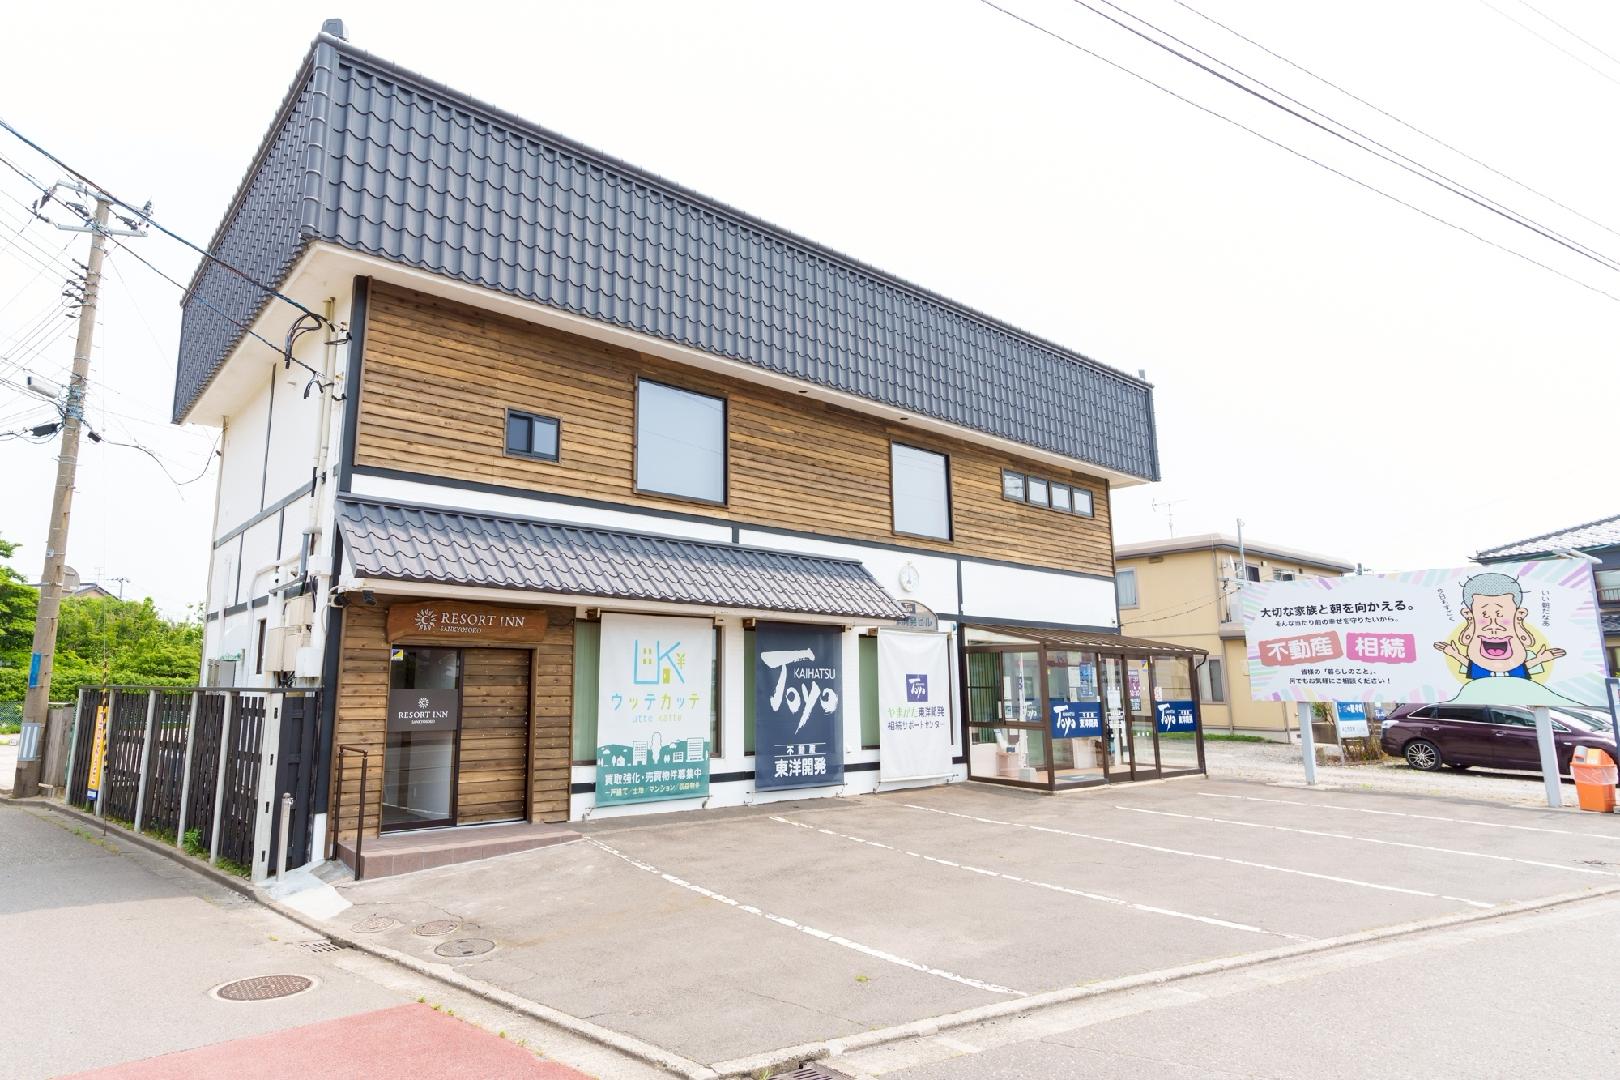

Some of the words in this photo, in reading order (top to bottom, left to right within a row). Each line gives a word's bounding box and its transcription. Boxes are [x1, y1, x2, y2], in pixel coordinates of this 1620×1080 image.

[1260, 600, 1415, 618] 大切な家族と朝を向かえる。
[440, 612, 497, 626] RESORT
[500, 616, 526, 627] INN
[1267, 636, 1334, 661] 不動産
[1355, 637, 1406, 659] 相続
[794, 667, 836, 679] KAIHATSU
[760, 647, 839, 735] Toyo
[611, 692, 700, 711] ウッテカッテ
[398, 711, 431, 719] RESORT
[432, 710, 449, 719] INN
[1053, 704, 1077, 737] Toyo
[1157, 703, 1176, 731] Toyo
[774, 756, 827, 778] 東洋開発
